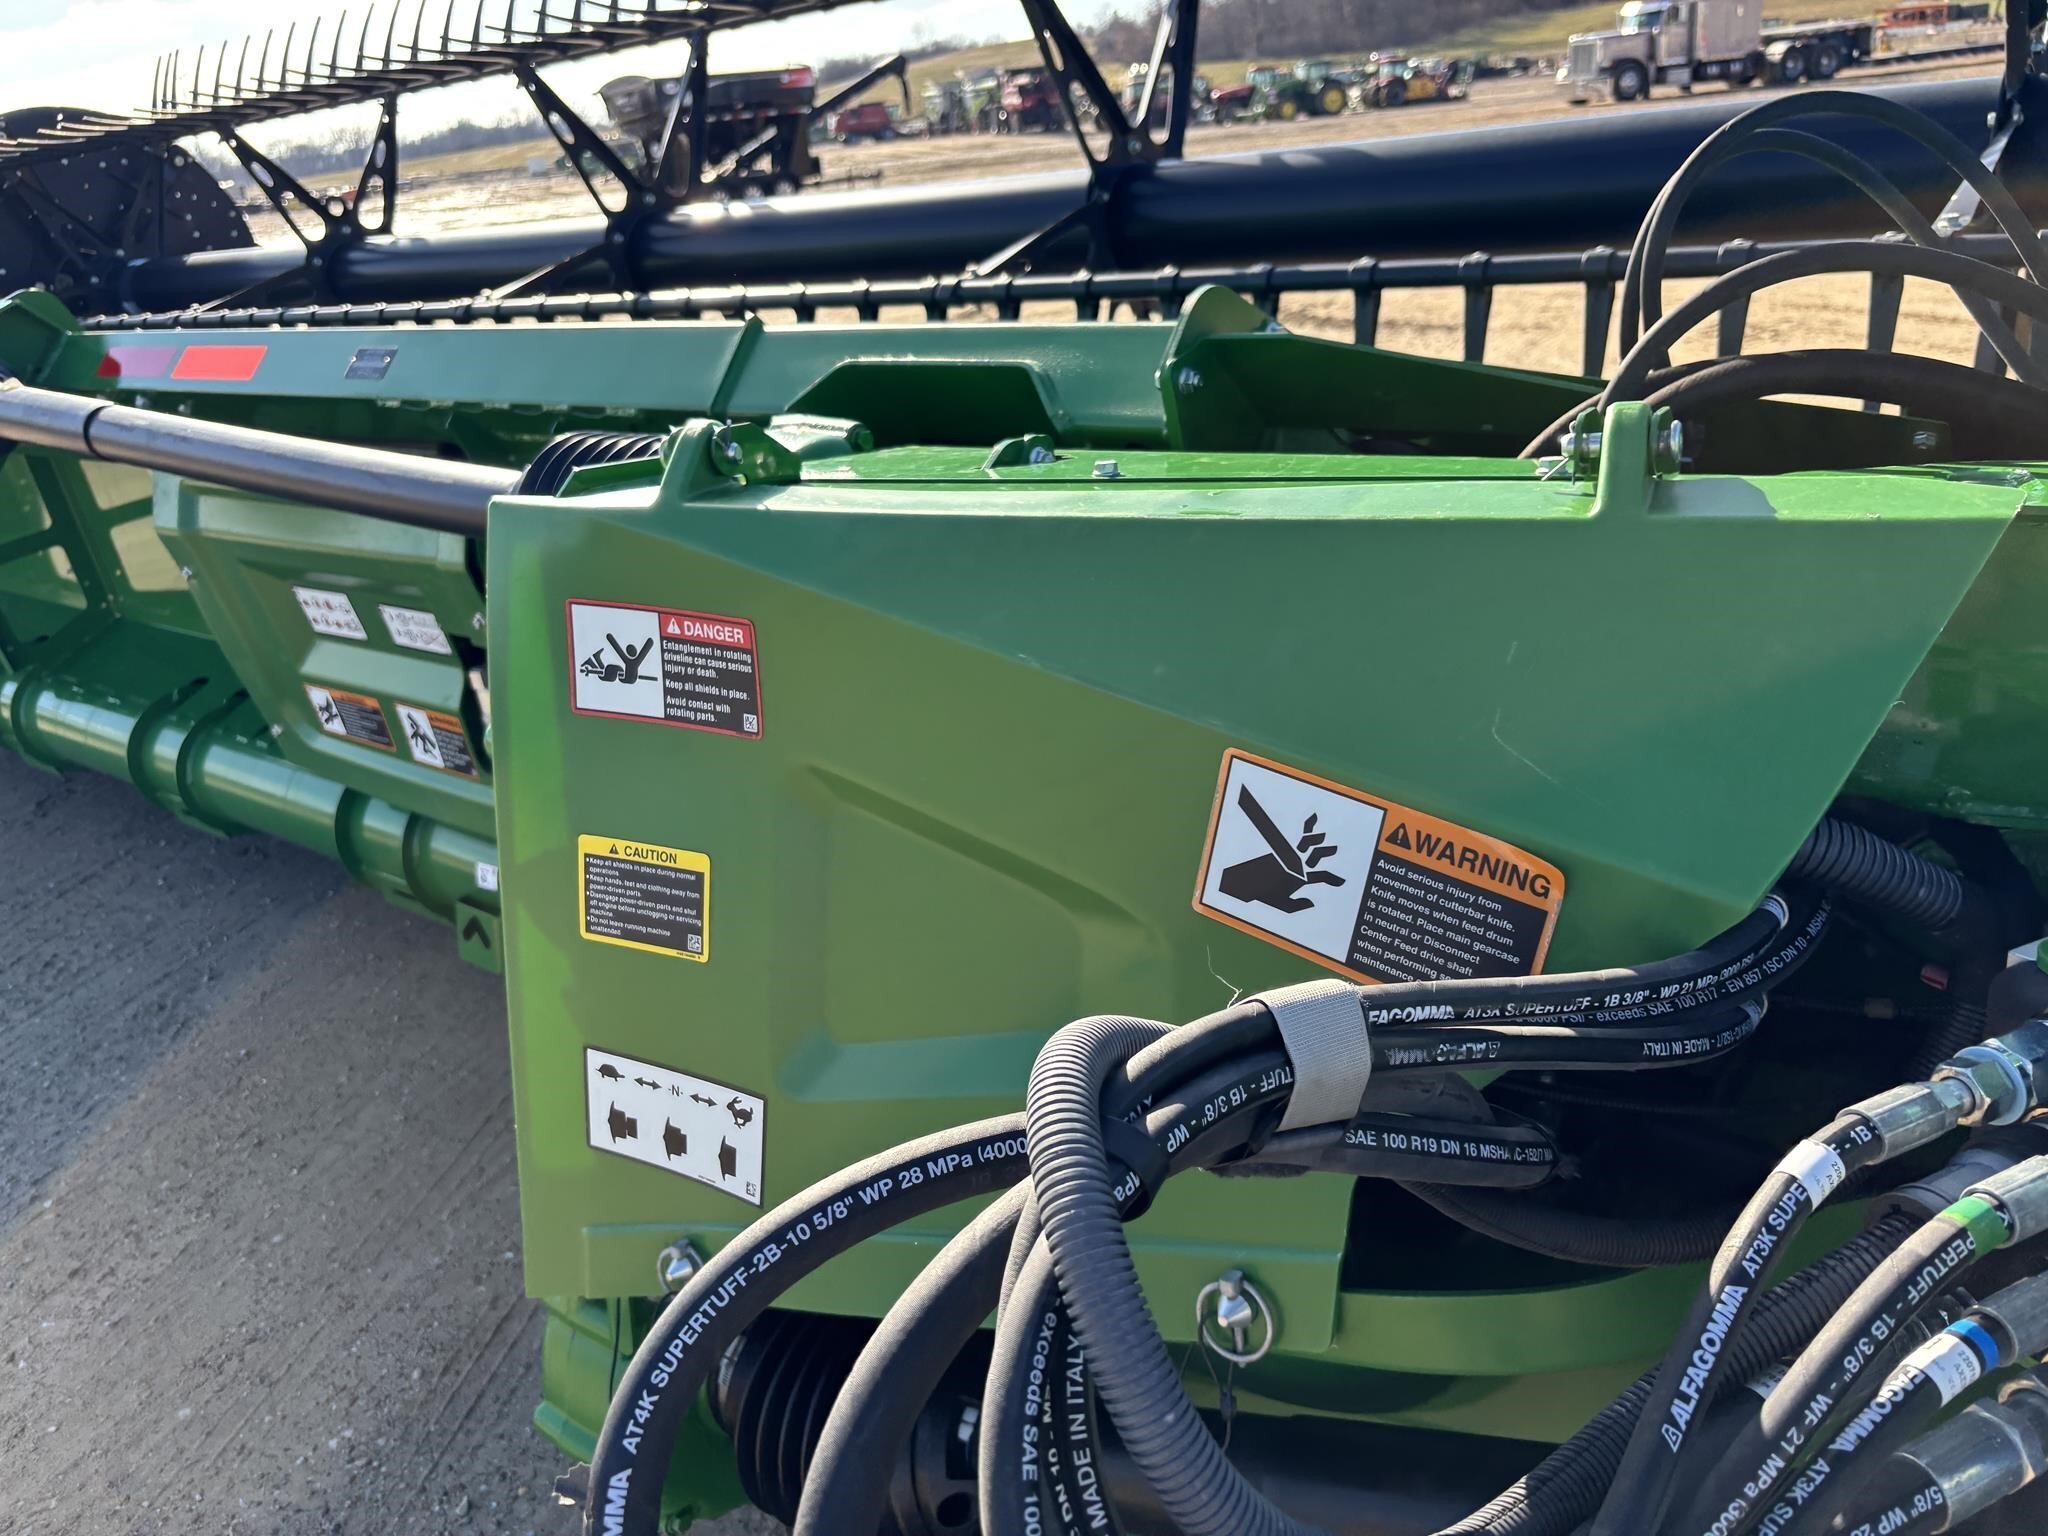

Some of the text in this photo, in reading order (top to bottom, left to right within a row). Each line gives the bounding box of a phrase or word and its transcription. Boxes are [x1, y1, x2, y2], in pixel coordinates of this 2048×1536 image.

[684, 621, 744, 644] DANGER
[663, 640, 752, 663] Entanglement in rotating
[664, 654, 752, 673] driveline can cause serious
[696, 667, 718, 679] death.
[666, 679, 750, 700] Keep all shields in place.
[667, 696, 730, 714] Avoid contact with
[667, 708, 718, 723] rotating parts.
[590, 858, 604, 866] Keep
[613, 860, 632, 870] shields
[641, 866, 656, 874] place
[657, 868, 676, 878] during
[676, 872, 696, 880] normal
[624, 846, 677, 864] CAUTION
[1416, 830, 1551, 899] WARNING
[590, 874, 604, 882] Keep
[648, 883, 670, 894] clothing
[672, 888, 686, 898] away
[687, 890, 700, 899] from
[590, 884, 626, 894] power-driven
[1378, 860, 1502, 912] Avoid serious injury from
[590, 890, 696, 915] Disengage power-driven parts and shut
[598, 902, 617, 910] engine
[618, 904, 636, 912] before
[636, 907, 668, 920] unclogging
[676, 914, 701, 926] servicing
[1371, 886, 1514, 946] Knife moves when feed drum
[1374, 874, 1516, 932] movement of cutterbar knife.
[610, 920, 624, 928] leave
[624, 924, 646, 933] running
[648, 926, 670, 936] machine
[1364, 912, 1480, 964] in neutral or Disconnect
[1368, 899, 1520, 964] is rotated. Place main gearcase
[1357, 938, 1438, 978] when performing
[1360, 926, 1392, 944] Center
[1394, 940, 1418, 954] Feed
[1420, 950, 1445, 965] drive
[1446, 960, 1473, 976] shaft
[1354, 952, 1414, 982] maintenance
[1597, 910, 1827, 1022] exceeds SAE 100 R17 EN 857 1SC DN 10 MSHA
[1604, 994, 1622, 1008] 1B
[1624, 990, 1649, 1006] 3/8"
[1660, 985, 1680, 1000] WP
[1682, 982, 1694, 994] 21
[1696, 975, 1718, 991] MPa
[1642, 1042, 1670, 1056] ITALY
[1672, 1042, 1682, 1055] IN
[1684, 1038, 1710, 1053] MADE
[1232, 1084, 1248, 1106] 1B
[1203, 1096, 1228, 1127] 3/8"
[1168, 1126, 1190, 1153] WP
[1346, 1130, 1376, 1146] SAE
[1382, 1134, 1406, 1149] 100
[1411, 1136, 1436, 1152] R19
[1441, 1140, 1460, 1156] DN
[1464, 1142, 1478, 1156] 16
[1480, 1144, 1511, 1160] MSHA
[1850, 1126, 1872, 1146] 1B
[625, 1389, 660, 1456] AT4K
[650, 1223, 812, 1390] SUPERTUFF-2B-10
[814, 1197, 855, 1232] 5/8"
[858, 1178, 894, 1206] WP
[898, 1167, 924, 1191] 28
[927, 1153, 973, 1180] MPa
[978, 1137, 1028, 1162] (4000
[1667, 1285, 1748, 1431] ALFAGOMMA
[1742, 1232, 1779, 1280] AT3K
[1871, 1313, 1897, 1342] 1B
[1025, 1312, 1058, 1416] exceeds
[1066, 1334, 1084, 1404] ITALY
[1843, 1341, 1874, 1382] 3/8"
[1069, 1414, 1088, 1440] IN
[1780, 1430, 1804, 1450] 21
[1022, 1424, 1038, 1481] SAE
[1048, 1448, 1074, 1522] DN 10
[1073, 1448, 1108, 1529] MADE
[1744, 1452, 1786, 1496] MPa
[1795, 1456, 1831, 1506] AT3K
[1912, 1485, 1944, 1518] 5/8"
[1878, 1506, 1908, 1534] WP
